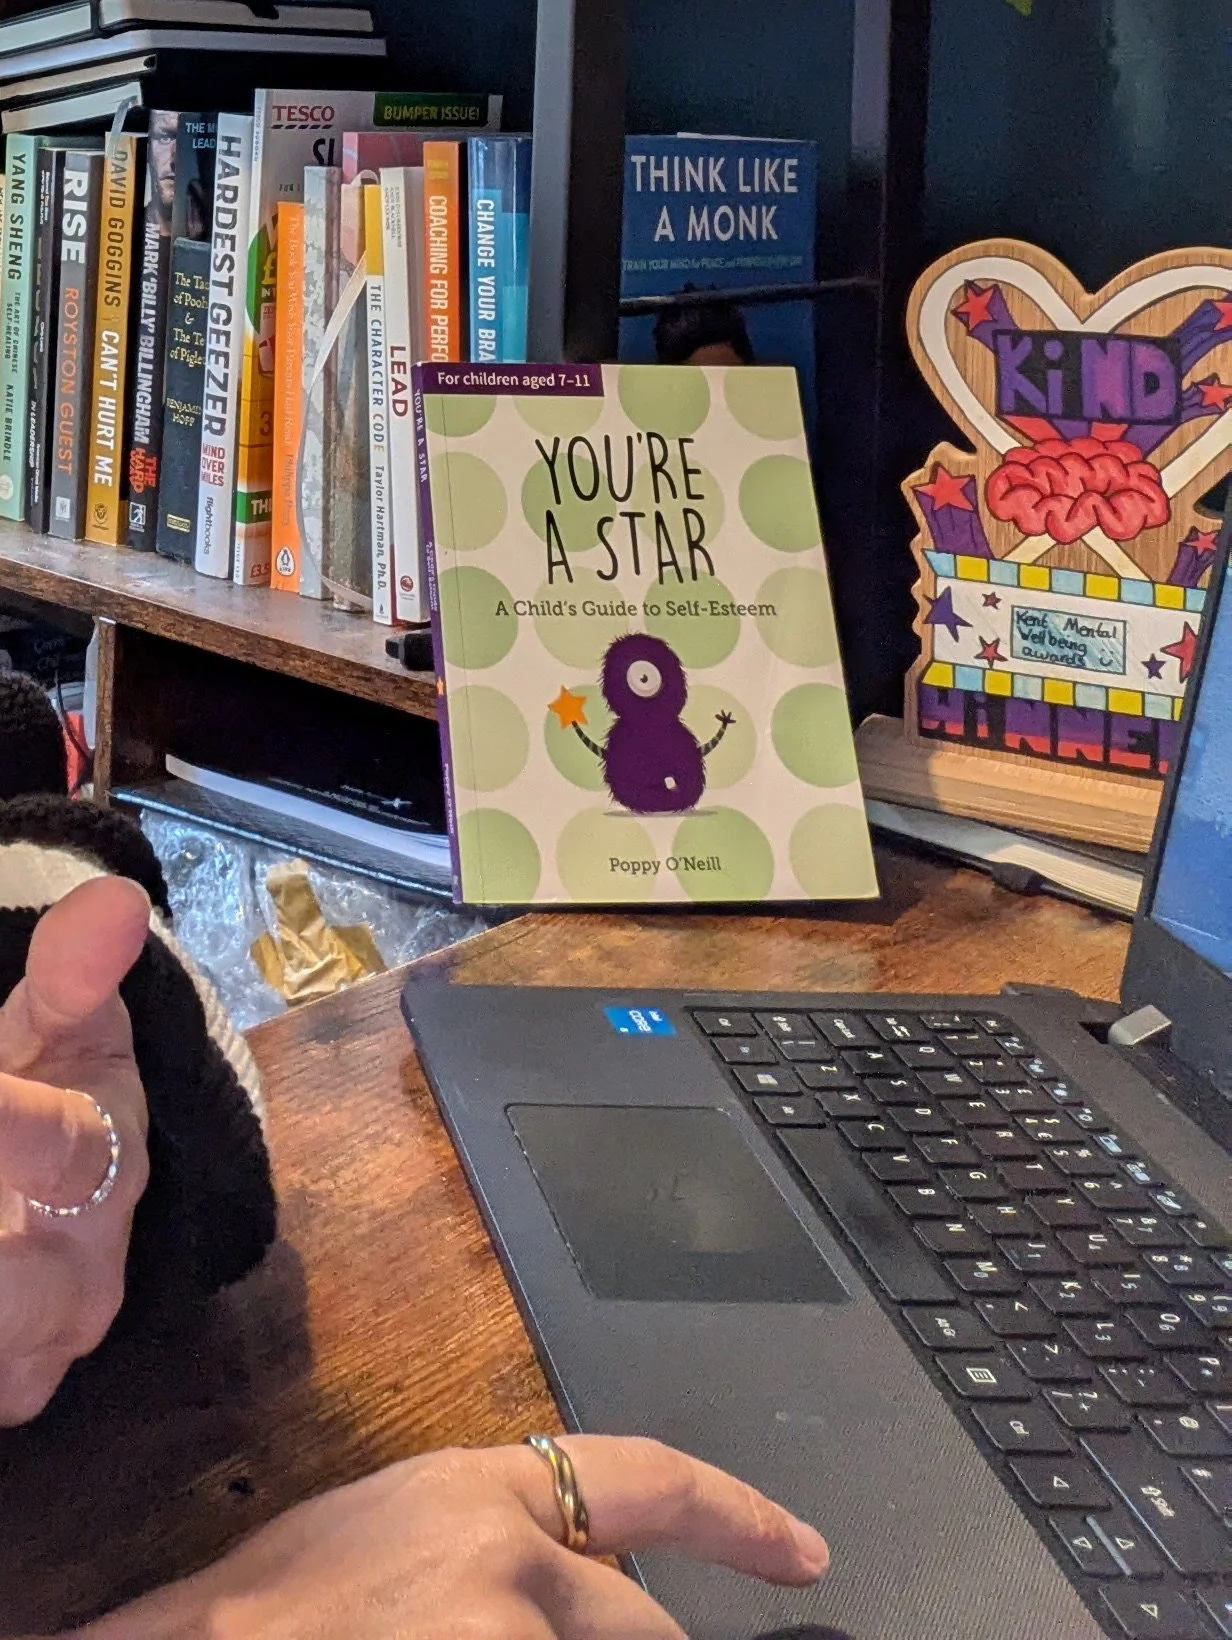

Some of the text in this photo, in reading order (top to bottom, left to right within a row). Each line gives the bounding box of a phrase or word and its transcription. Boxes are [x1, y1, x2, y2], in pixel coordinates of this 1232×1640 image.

[271, 105, 335, 122] TESCO
[384, 105, 437, 121] BUMPER
[630, 155, 799, 193] THINK LIKE
[7, 153, 26, 281] YANG SHENG
[428, 195, 449, 275] COACHING
[654, 205, 779, 242] A MONK
[143, 222, 161, 275] MARK
[174, 271, 191, 286] The
[203, 135, 242, 437] HARDEST GEEZER
[429, 279, 449, 309] FOR
[477, 199, 497, 363] CHANGE YOUR BRA
[173, 291, 184, 305] of
[57, 170, 89, 476] RISE ROYSTON GUEST
[93, 150, 129, 488] DAVID GOGGINS CAN'T HURT ME
[173, 327, 190, 344] The
[170, 346, 181, 360] of
[430, 314, 449, 363] PERFO
[133, 335, 155, 445] BILLINGHAM
[389, 345, 408, 417] LEAD
[437, 371, 460, 386] For
[463, 371, 519, 386] children
[522, 373, 555, 390] aged
[3, 384, 15, 463] KATIE BRINDLE
[173, 412, 195, 426] HOFF
[370, 284, 387, 590] THE CHARACTER CODE Taylor Hartman, Ph.D.
[28, 412, 37, 469] LEADERSHIP
[202, 443, 226, 460] MIND
[133, 447, 146, 495] HARD
[144, 456, 158, 488] THE
[200, 471, 225, 487] MILES
[201, 456, 225, 475] OVER
[535, 432, 705, 505] YOU'RE
[203, 496, 214, 556] flightbooks
[545, 507, 715, 585] A STAR
[495, 600, 777, 617] A Child's Guide to Self-Esteem
[1015, 610, 1117, 639] Kent Mental
[1021, 646, 1087, 668] awards
[608, 856, 722, 876] Poppy O'Neill
